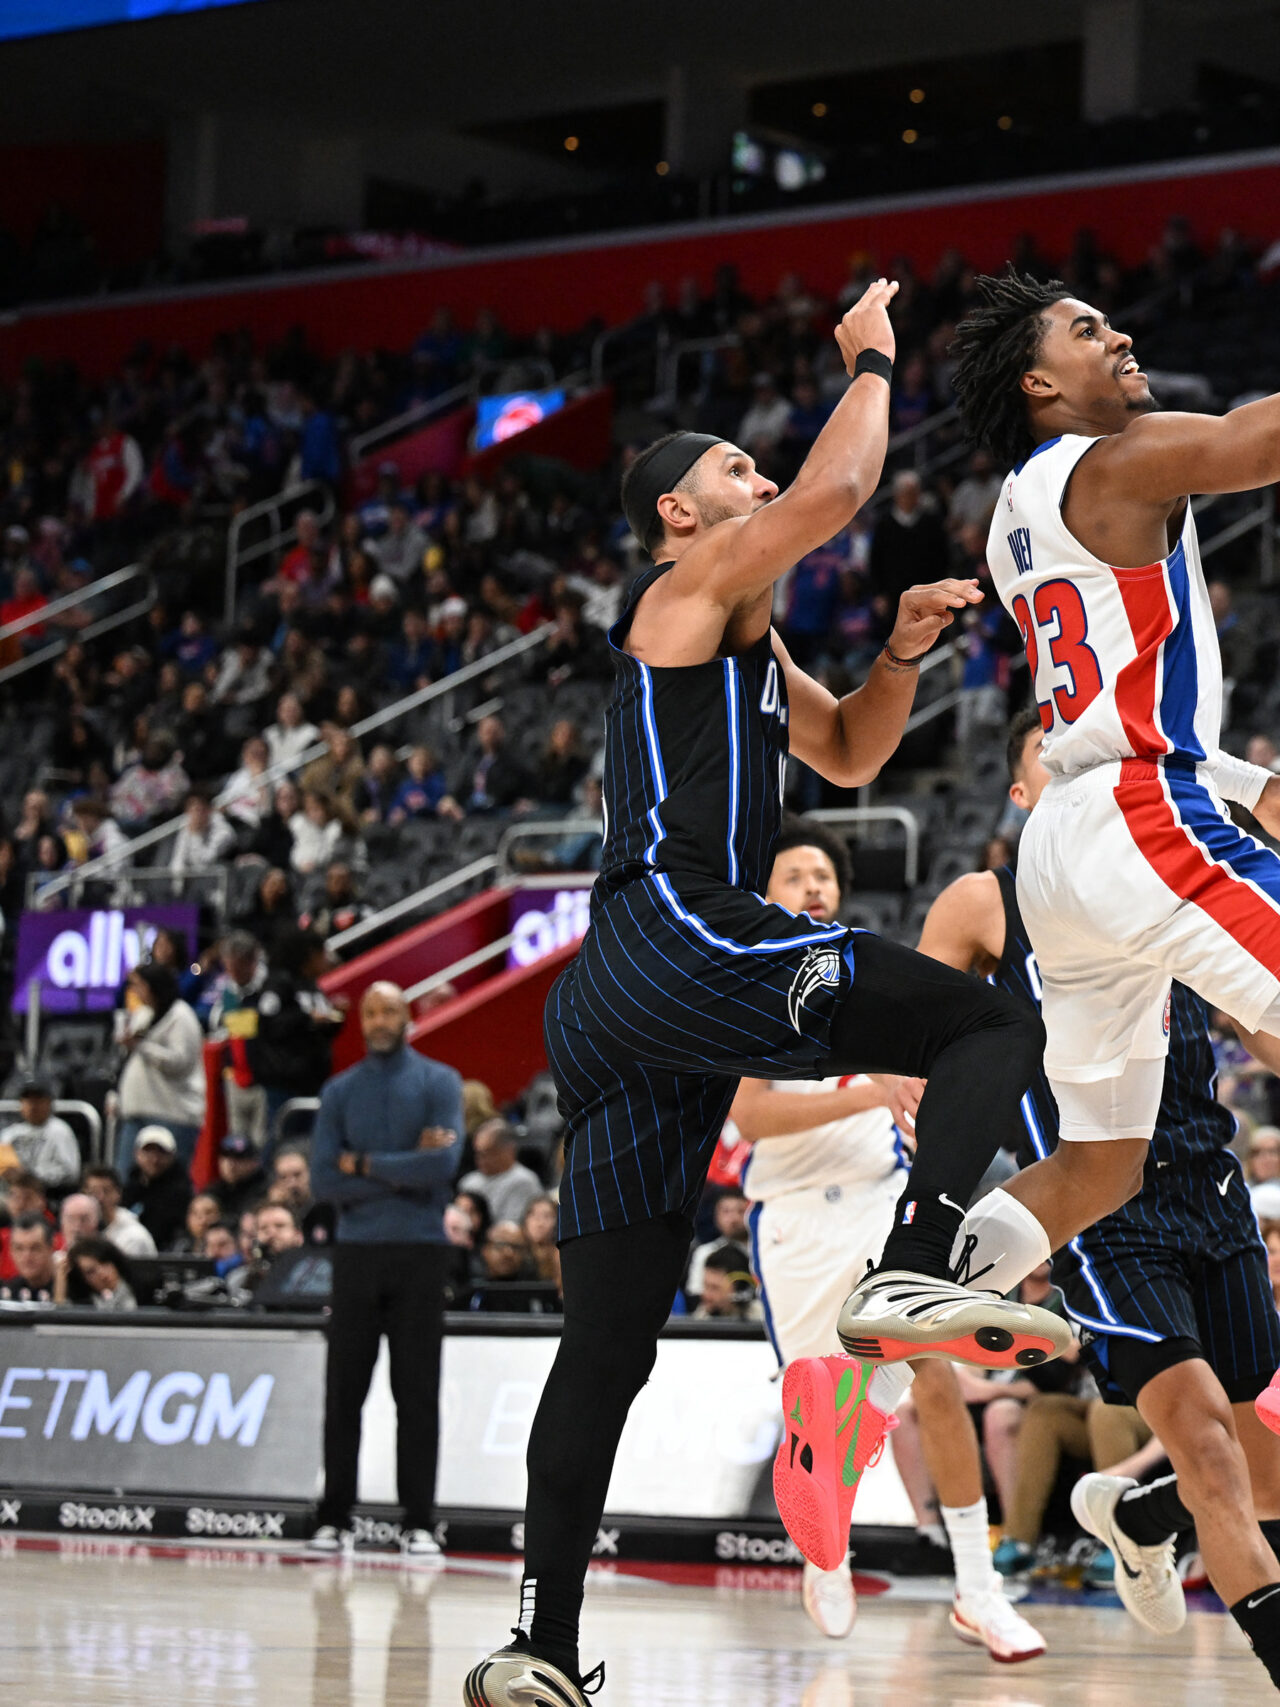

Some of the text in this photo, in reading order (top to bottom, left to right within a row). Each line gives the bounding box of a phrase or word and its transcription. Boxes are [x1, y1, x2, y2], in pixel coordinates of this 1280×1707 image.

[1007, 527, 1034, 576] IVEY
[1012, 578, 1104, 734] 23
[510, 889, 590, 967] all
[0, 1367, 275, 1447] ETMGM
[59, 1501, 156, 1531] StockX
[185, 1507, 286, 1538] StockX
[715, 1531, 806, 1563] Stock
